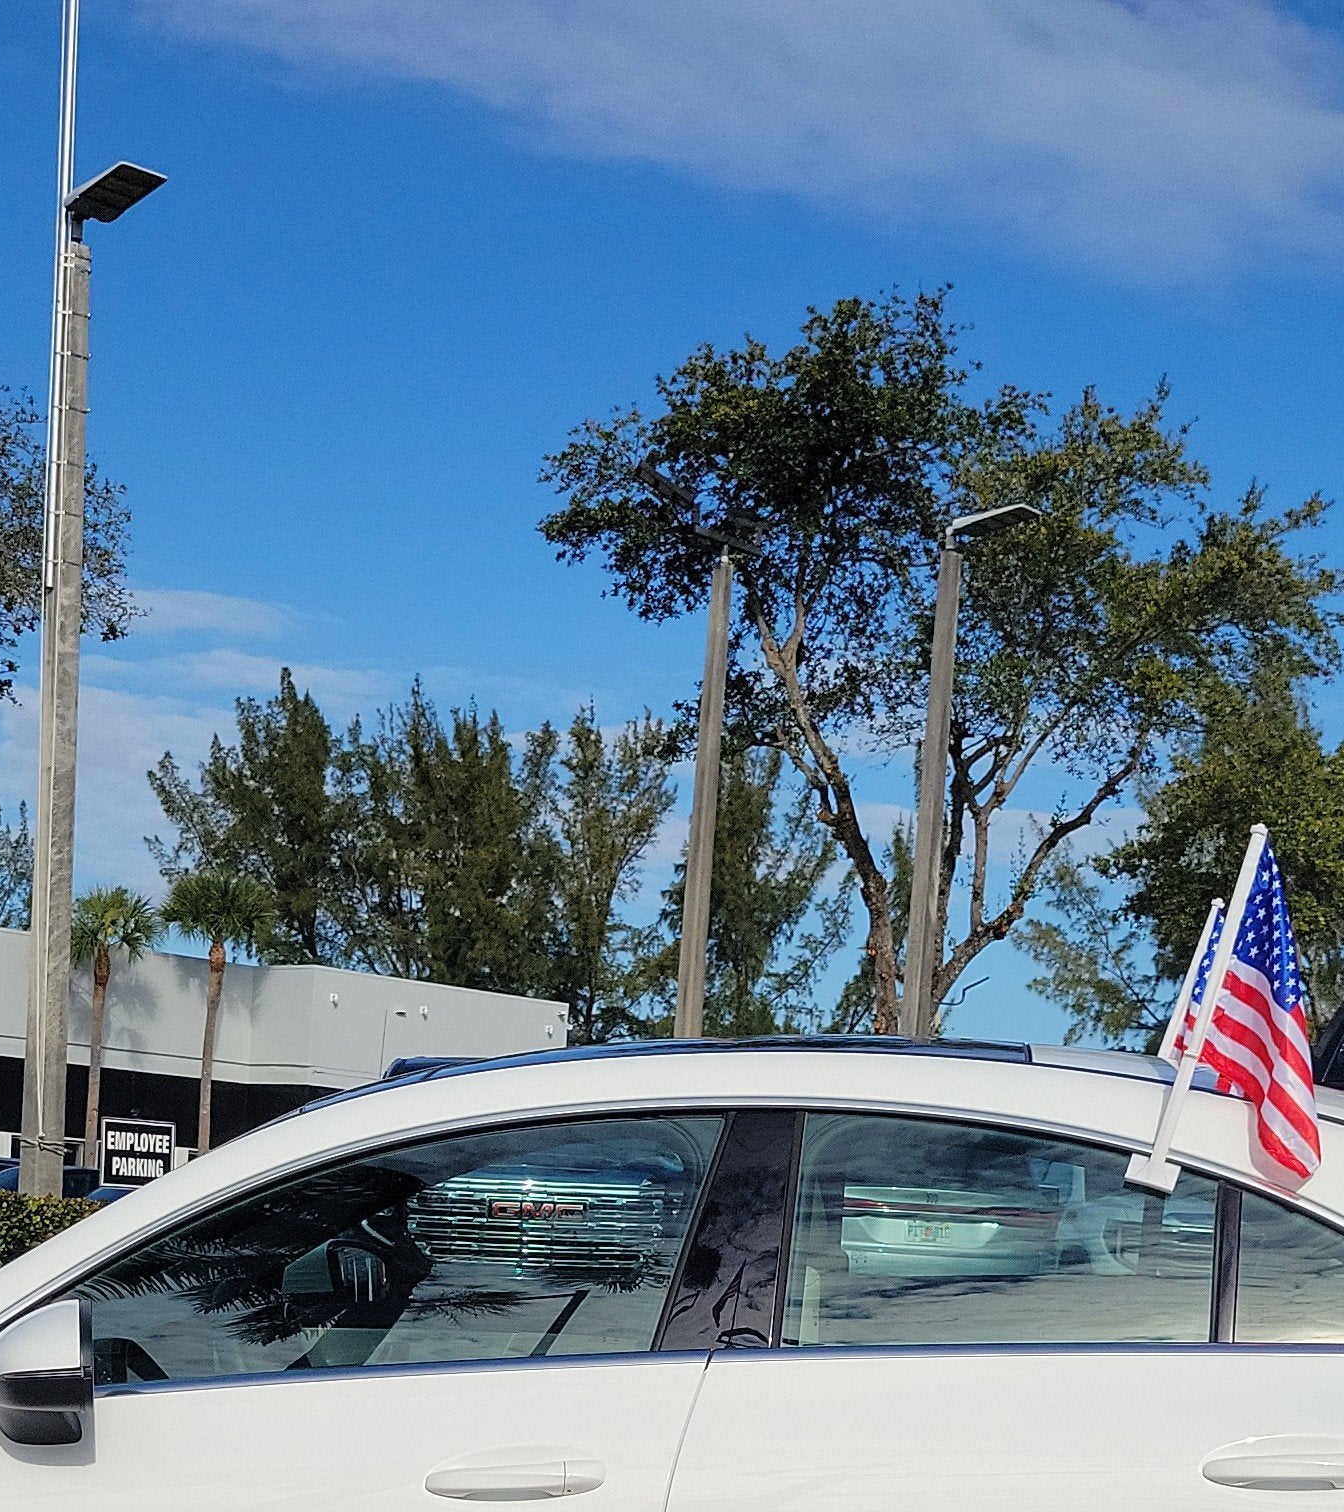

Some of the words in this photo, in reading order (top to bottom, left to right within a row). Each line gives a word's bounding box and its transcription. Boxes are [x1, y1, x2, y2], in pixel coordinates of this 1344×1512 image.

[106, 1130, 170, 1154] EMPLOYEE
[111, 1156, 164, 1178] PARKING
[491, 1201, 585, 1220] GMC
